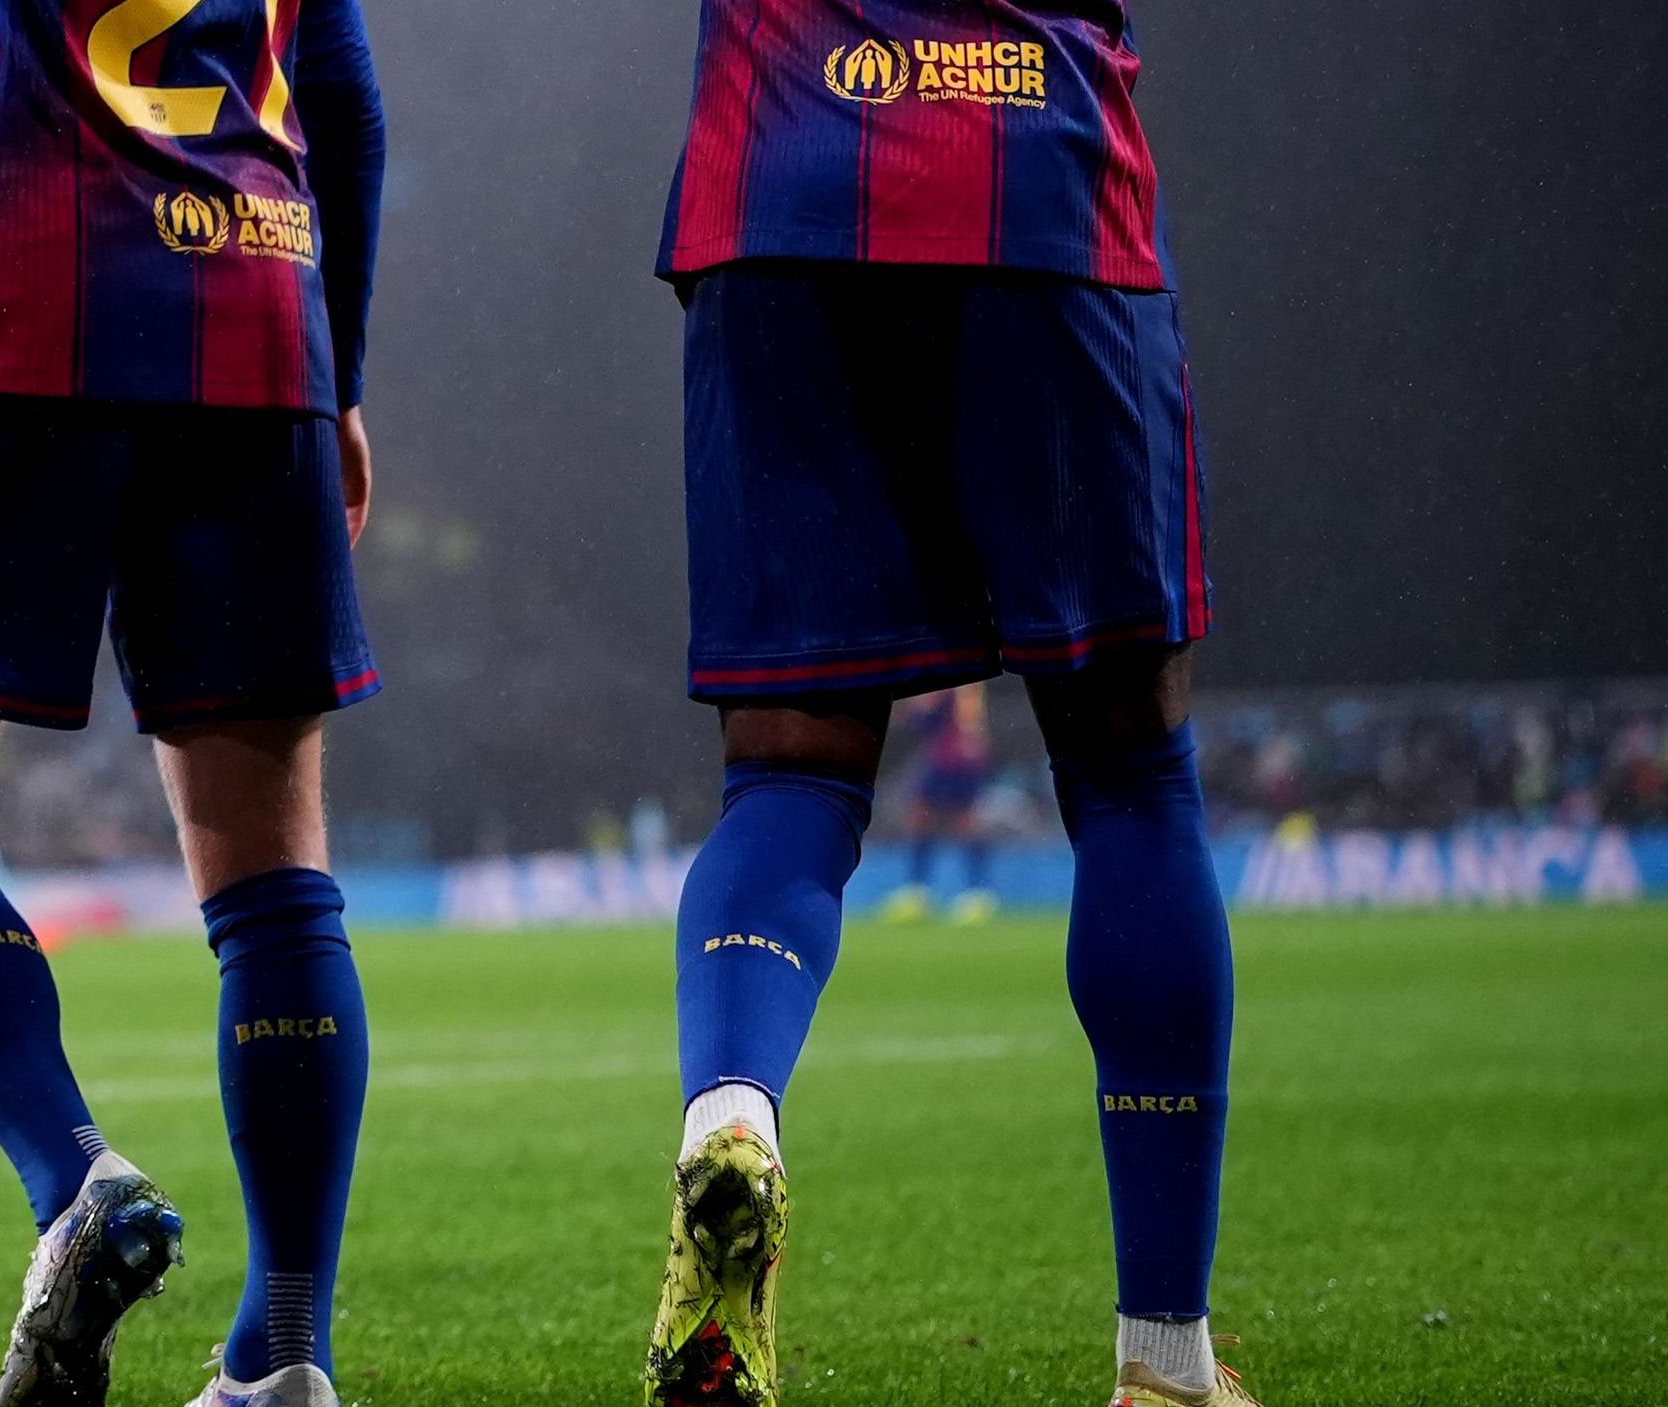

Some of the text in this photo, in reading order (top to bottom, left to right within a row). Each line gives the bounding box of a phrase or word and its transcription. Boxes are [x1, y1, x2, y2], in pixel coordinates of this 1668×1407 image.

[913, 39, 1045, 70] UNHCR
[916, 62, 1046, 97] ACNUR
[919, 90, 1047, 110] The UN Refugee Agency
[234, 193, 311, 232] UNHCR
[238, 219, 314, 258] ACNUR
[234, 1015, 338, 1046] BARÇA
[1103, 1093, 1198, 1114] BARÇA
